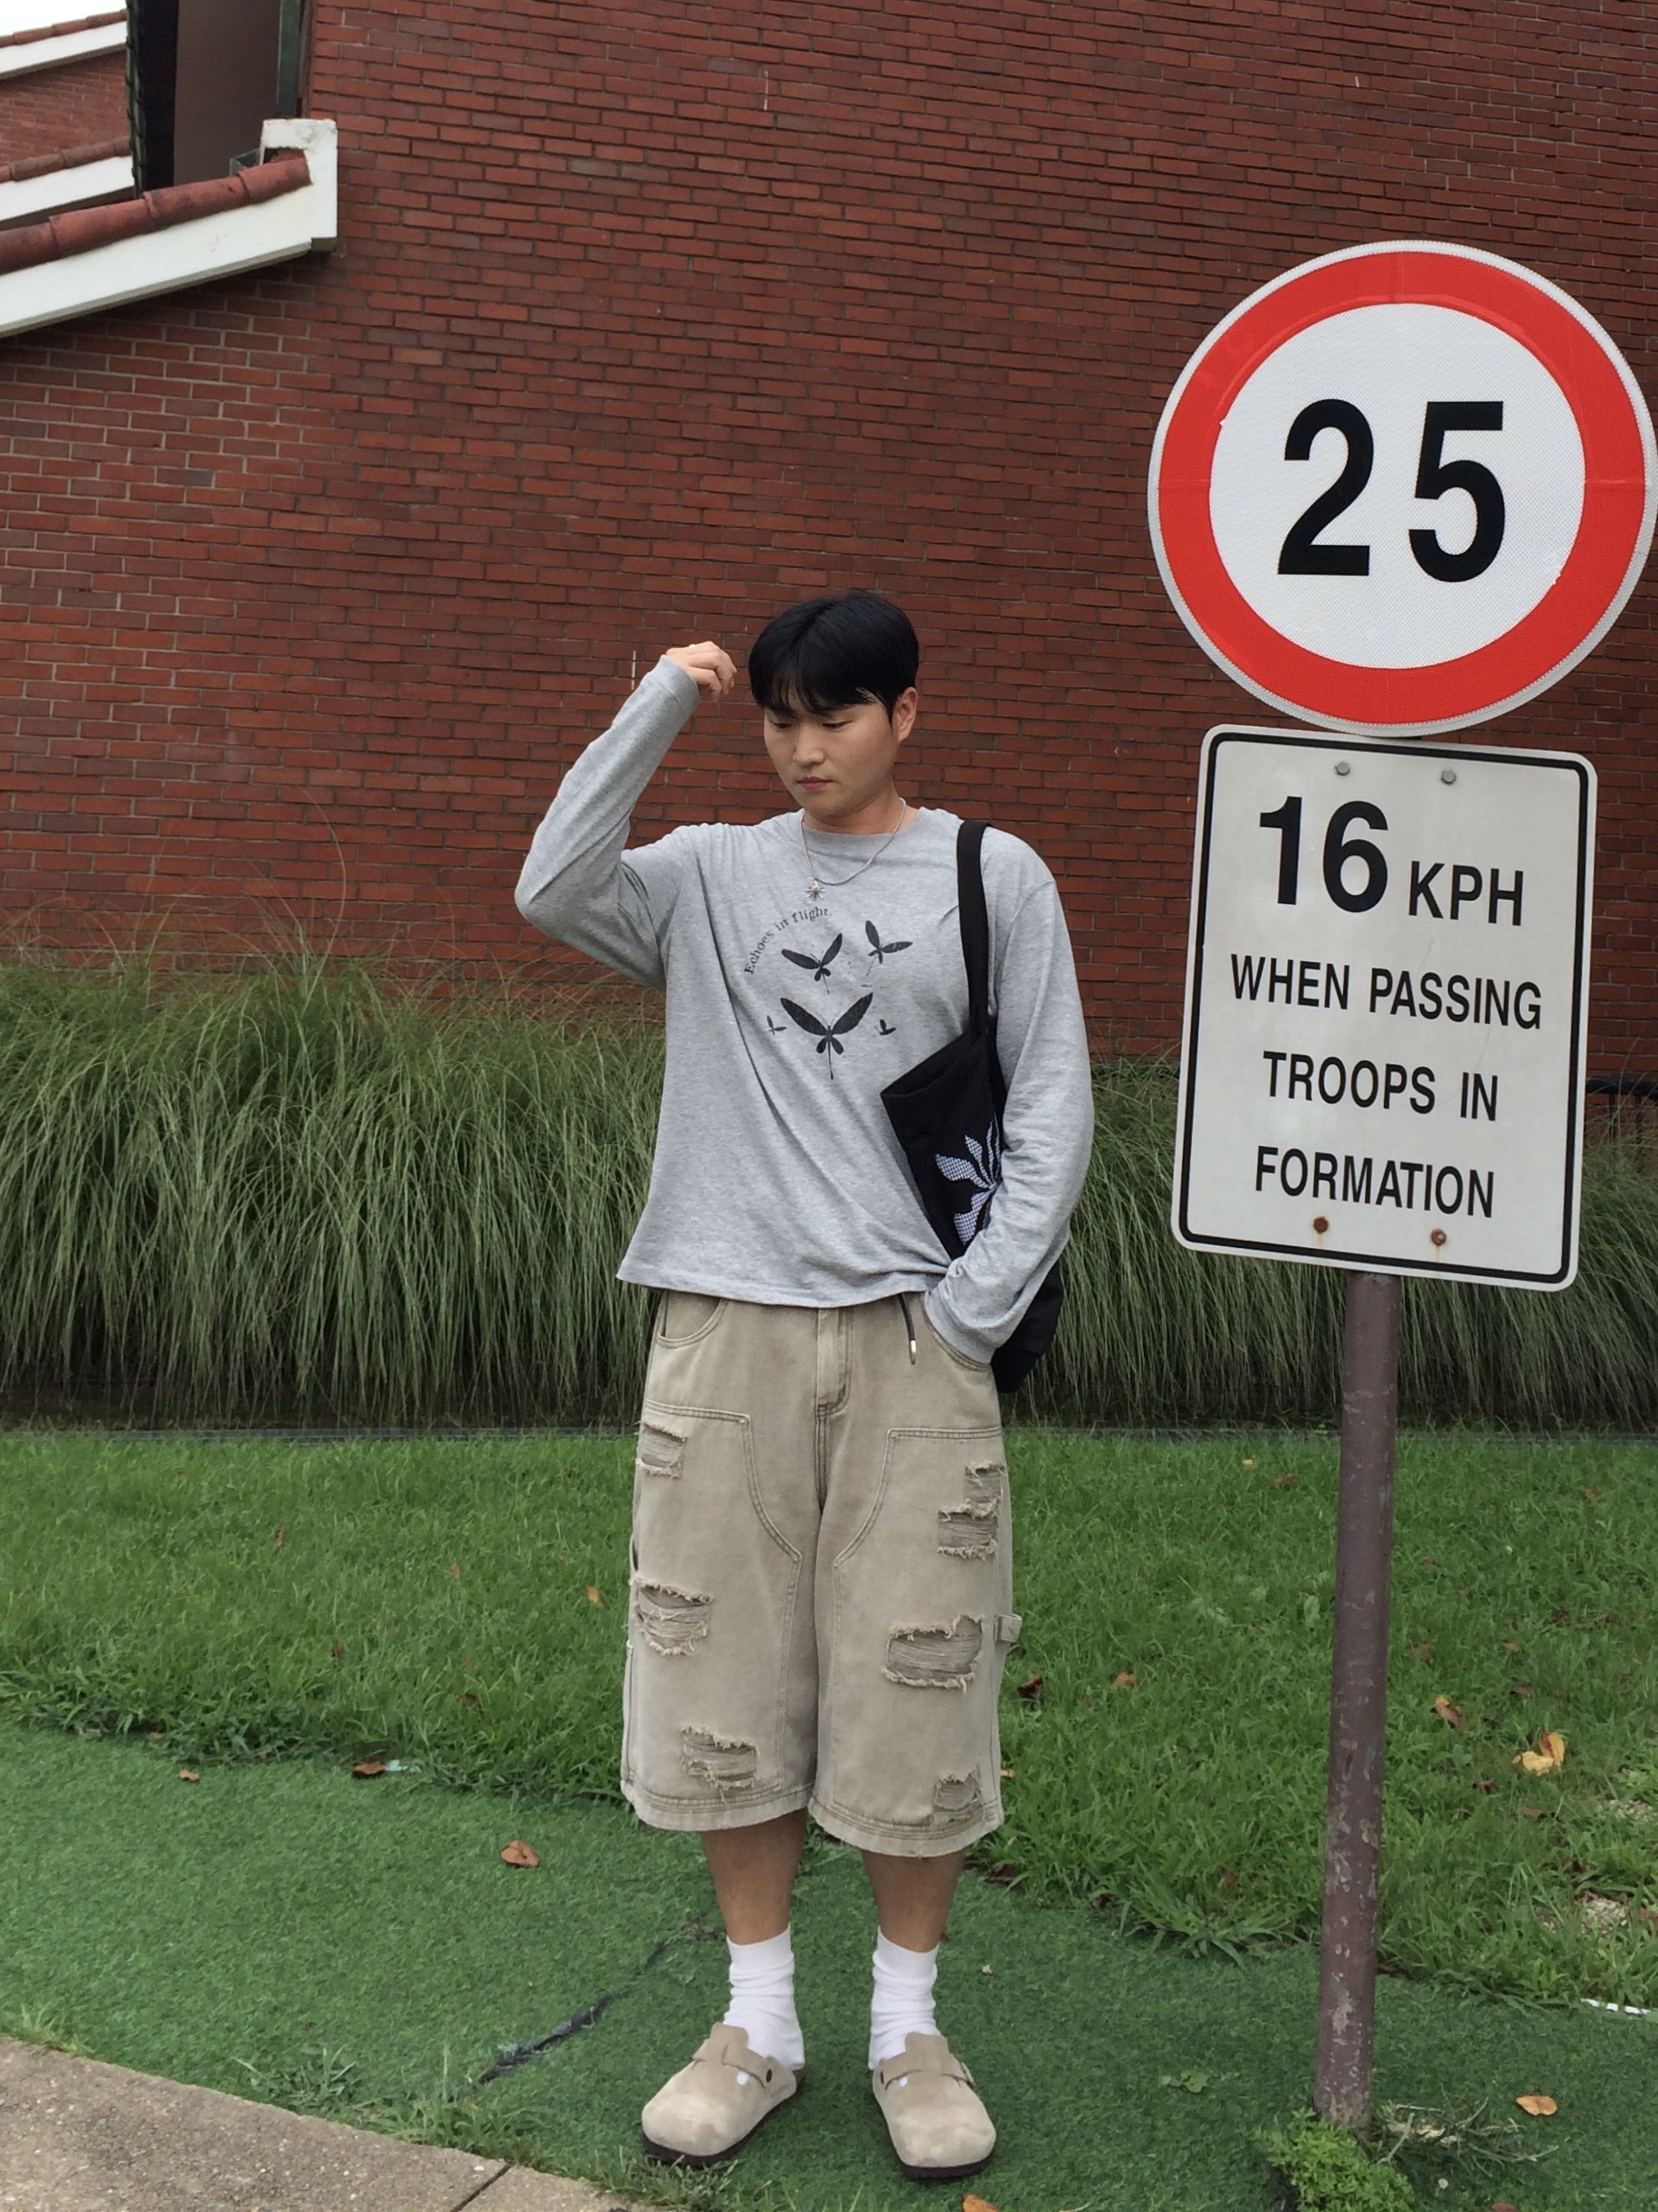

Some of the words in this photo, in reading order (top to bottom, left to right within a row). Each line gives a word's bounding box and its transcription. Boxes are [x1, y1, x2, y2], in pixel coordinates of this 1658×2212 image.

[1277, 398, 1506, 583] 25
[1259, 796, 1388, 913] 16
[1408, 860, 1524, 927] KPH
[743, 930, 775, 975] Echoes
[775, 919, 789, 931] in
[1231, 953, 1350, 1010] WHEN
[1369, 968, 1541, 1030] PASSING
[1263, 1050, 1435, 1114] TROOPS
[1460, 1072, 1498, 1121] IN
[1255, 1145, 1494, 1218] FORMATION
